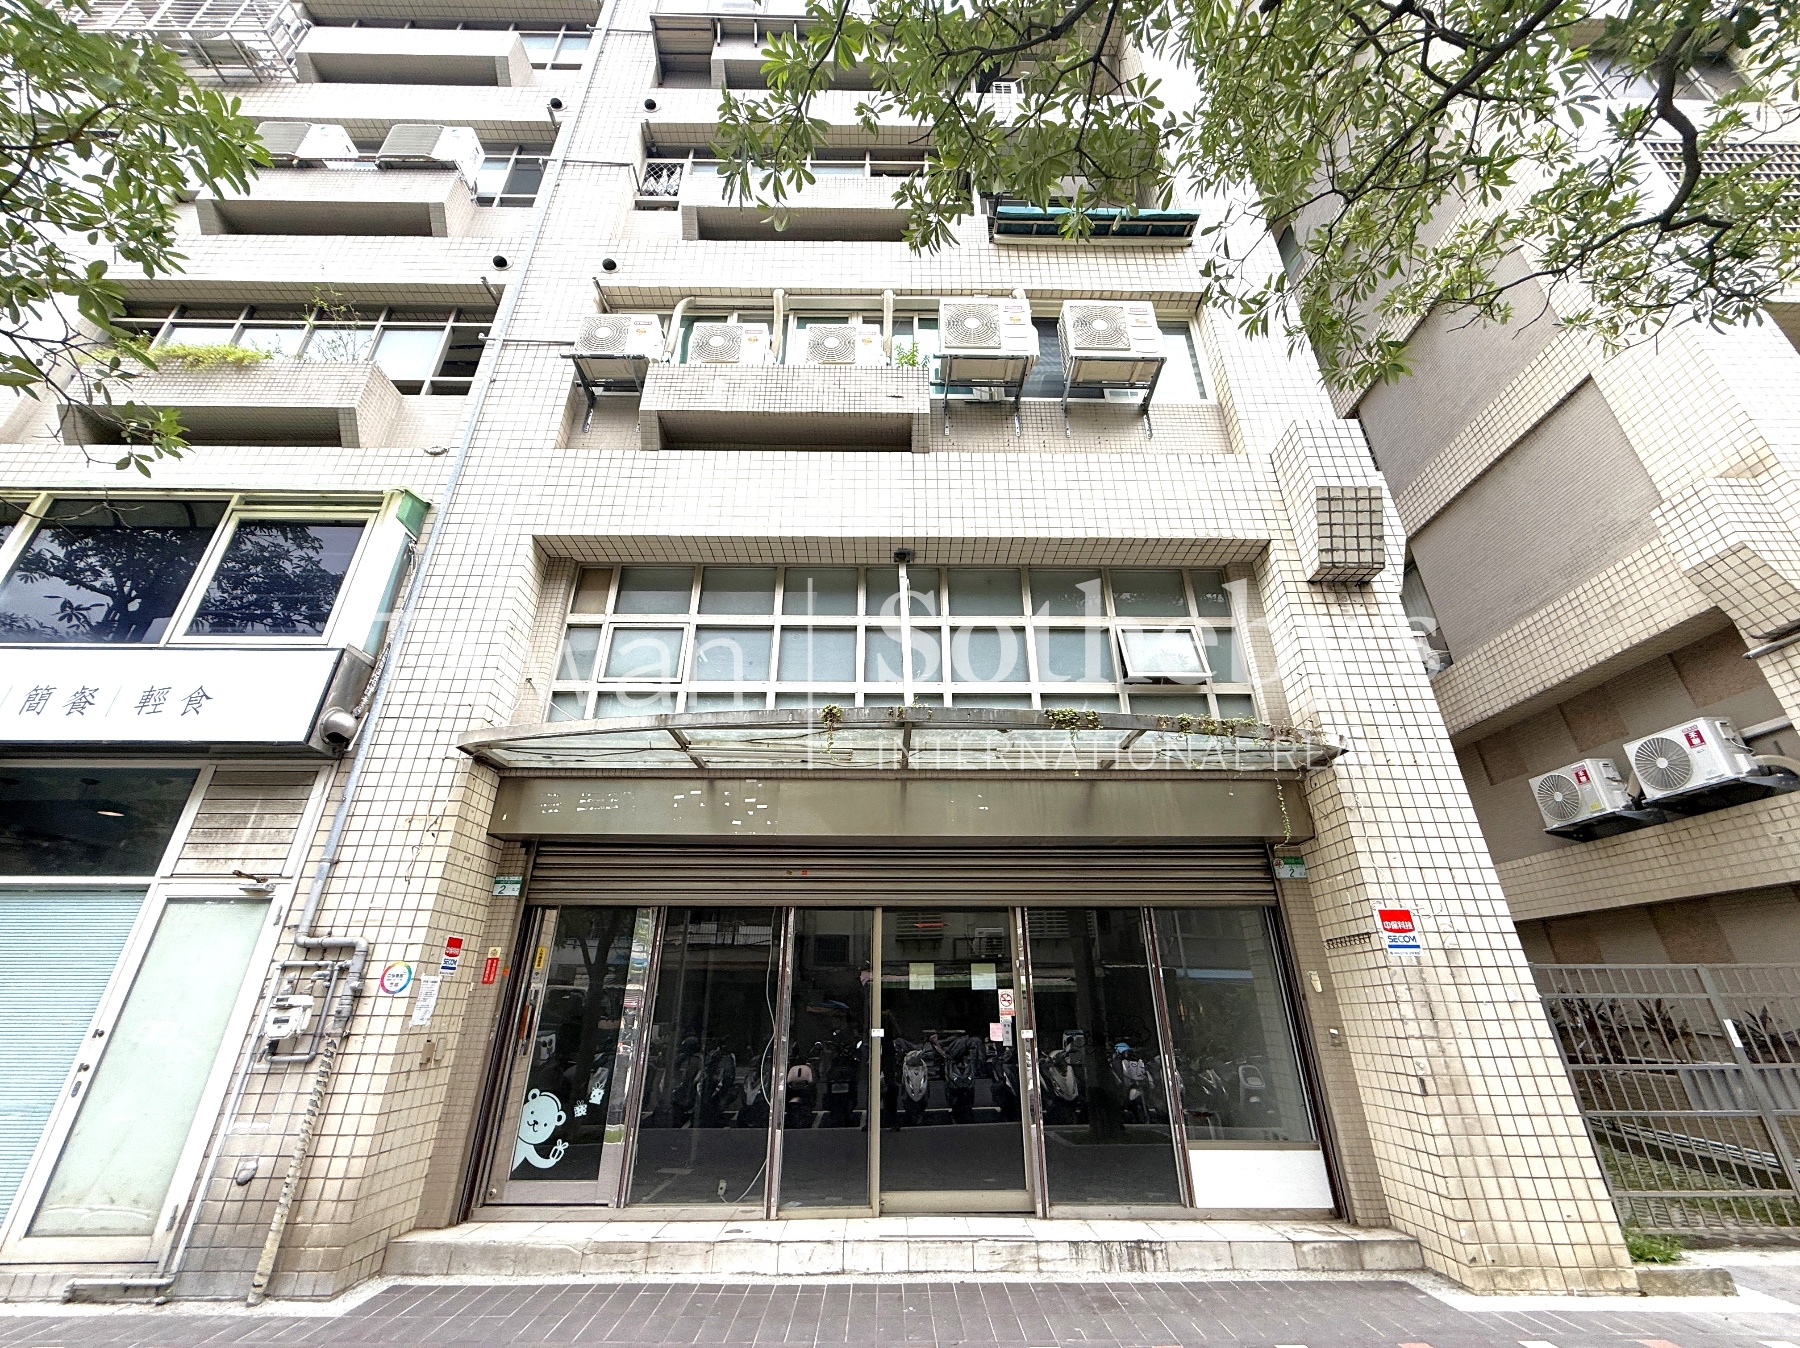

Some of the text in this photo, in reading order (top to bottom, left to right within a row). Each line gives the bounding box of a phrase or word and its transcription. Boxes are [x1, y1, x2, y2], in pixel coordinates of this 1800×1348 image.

[19, 684, 214, 716] 簡餐 輕食
[1387, 935, 1418, 943] SECOM
